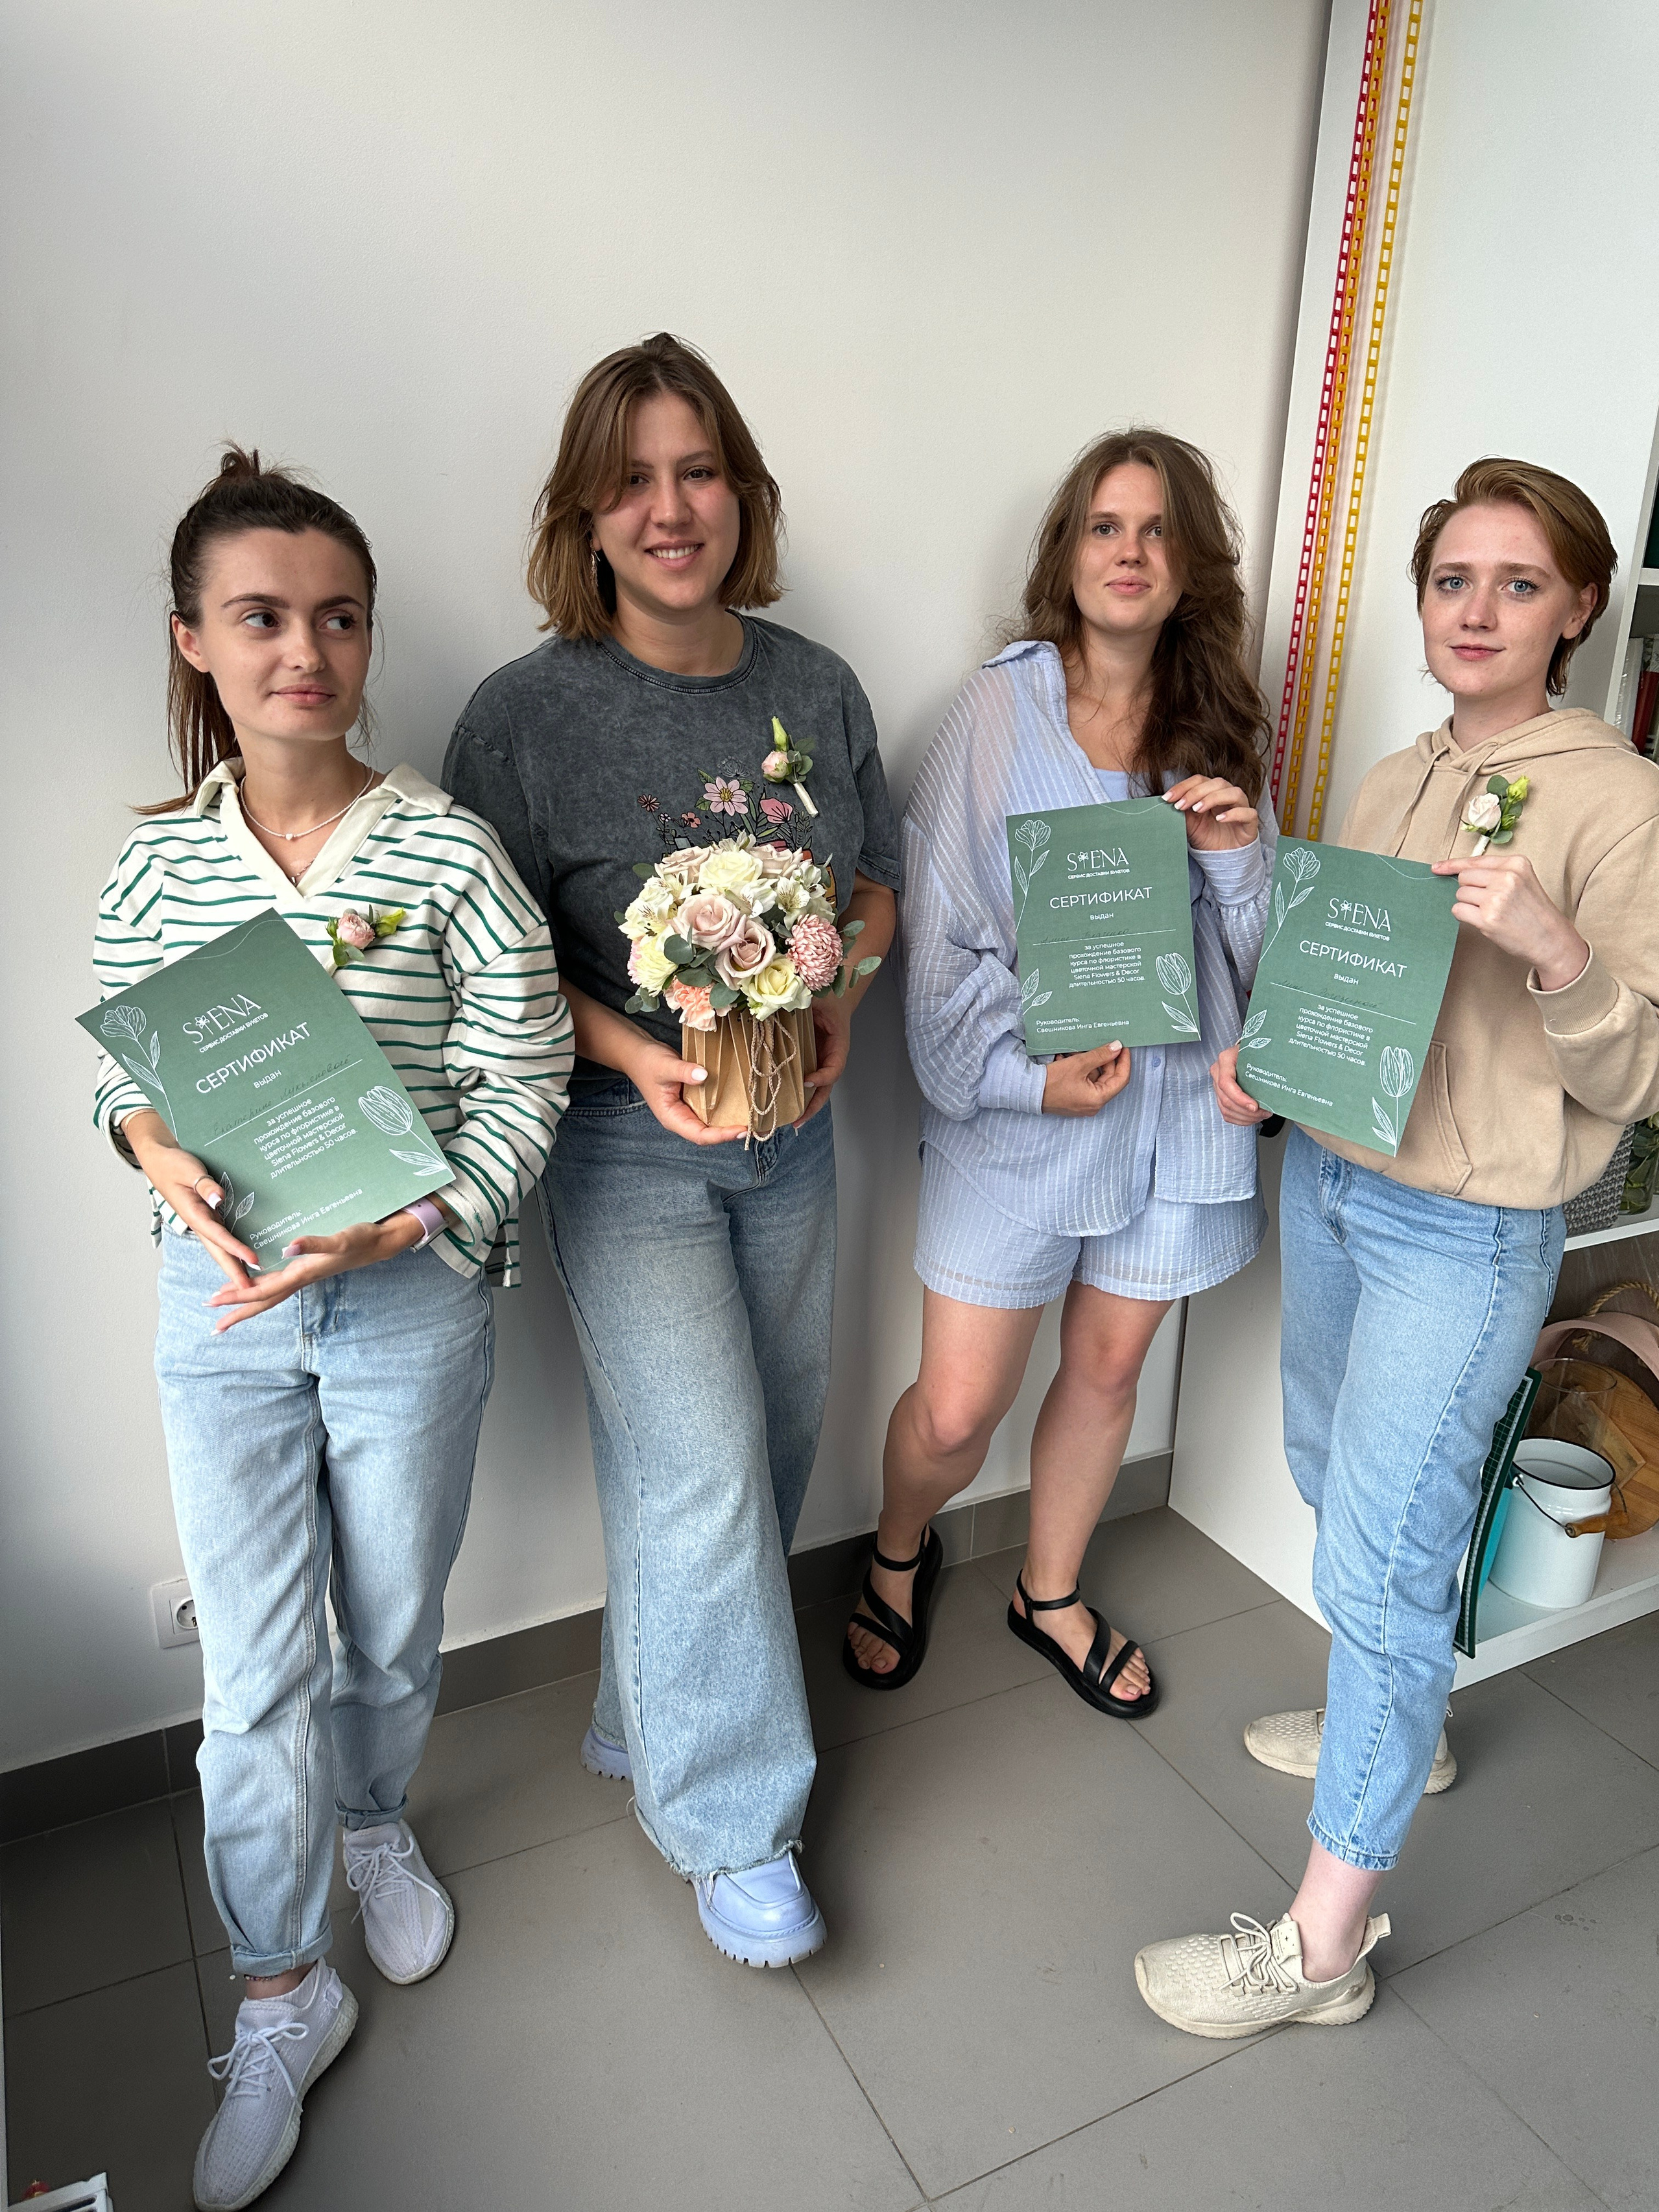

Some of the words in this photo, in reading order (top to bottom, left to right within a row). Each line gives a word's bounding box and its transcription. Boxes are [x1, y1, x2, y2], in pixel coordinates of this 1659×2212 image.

[1049, 886, 1152, 909] СЕРТИФИКАТ
[1069, 950, 1112, 960] прохождение
[1092, 942, 1125, 951] успешное
[1098, 955, 1136, 964] флористике
[1299, 940, 1407, 979] СЕРТИФИКАТ
[1070, 964, 1104, 973] цветочной
[1104, 960, 1142, 969] мастерской
[1333, 973, 1359, 985] выдан
[1069, 979, 1117, 989] длительностью
[1093, 1020, 1130, 1029] Евгеньевна
[1299, 1007, 1343, 1025] прохождение
[1343, 1019, 1374, 1033] базового
[1324, 1006, 1359, 1021] успешное
[1295, 1023, 1330, 1038] цветочной
[1330, 1034, 1368, 1049] мастерской
[1298, 1016, 1316, 1025] курса
[1326, 1023, 1365, 1040] флористике
[1288, 1038, 1337, 1056] длительностью
[1337, 1051, 1346, 1060] 50
[1346, 1056, 1366, 1066] часов.
[1296, 1030, 1313, 1041] Siena
[1314, 1036, 1338, 1049] Flowers
[1344, 1045, 1364, 1056] Decor
[196, 1021, 311, 1093] СЕРТИФИКАТ
[253, 1069, 282, 1089] выдан
[1245, 1071, 1281, 1089] Свешникова
[1281, 1084, 1296, 1094] Инга
[1296, 1089, 1333, 1106] Евгеньевна
[254, 1115, 303, 1145] прохождение
[302, 1097, 335, 1117] базового
[266, 1118, 276, 1126] за
[275, 1099, 313, 1123] успешное
[259, 1137, 281, 1152] курса
[280, 1132, 291, 1141] по
[291, 1108, 335, 1136] флористике
[264, 1135, 303, 1161] цветочной
[302, 1112, 345, 1139] мастерской
[270, 1152, 292, 1167] Siena
[291, 1137, 320, 1156] Flowers
[324, 1123, 346, 1138] Decor
[270, 1145, 325, 1180] длительностью
[324, 1139, 335, 1149] 50
[334, 1128, 358, 1142] часов.
[254, 1222, 301, 1250] Свешникова
[300, 1211, 320, 1225] Инга
[319, 1188, 363, 1215] Евгеньевна
